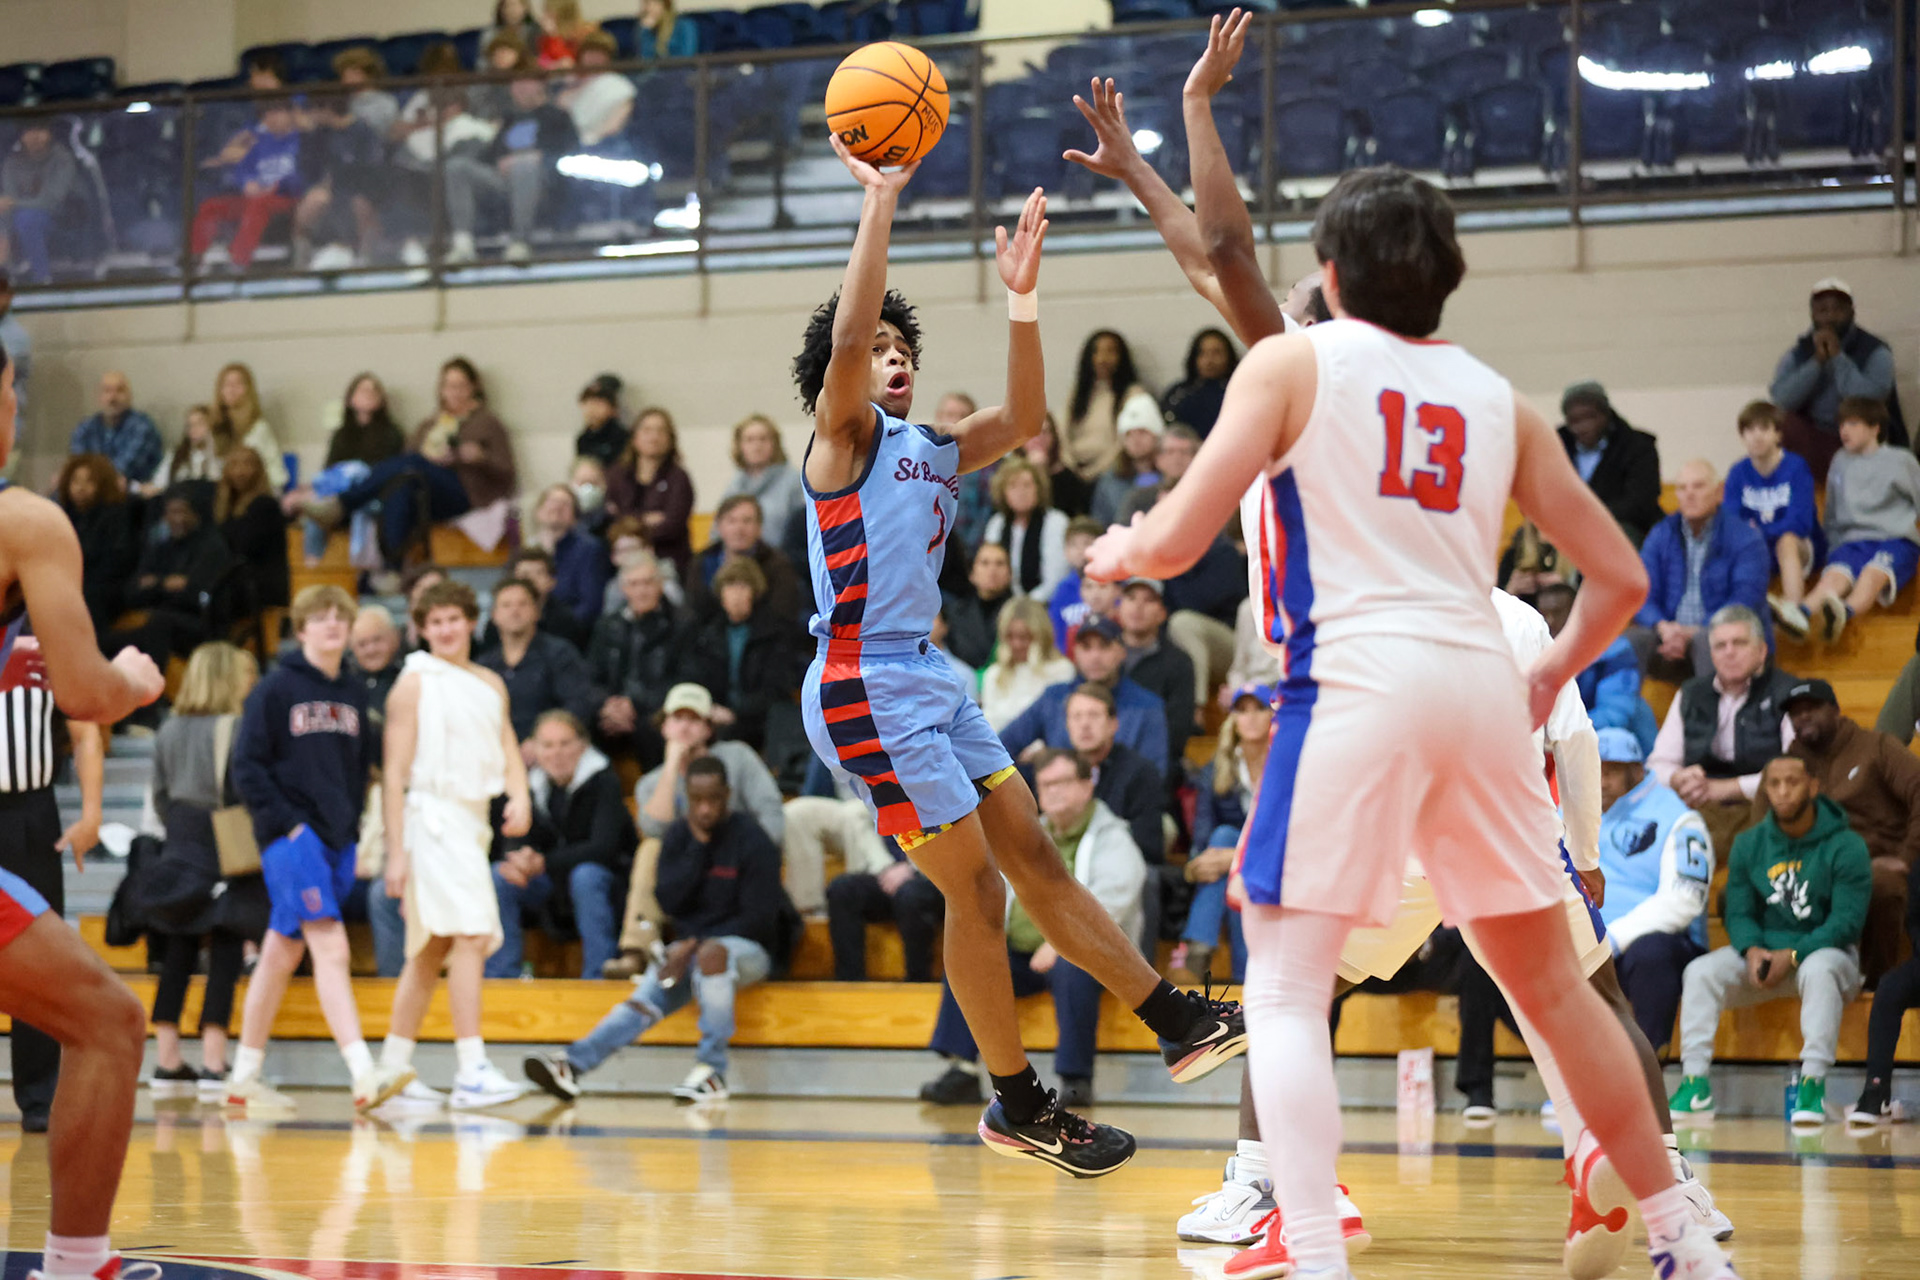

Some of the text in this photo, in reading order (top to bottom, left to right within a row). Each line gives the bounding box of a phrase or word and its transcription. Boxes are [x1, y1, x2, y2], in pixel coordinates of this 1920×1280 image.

[921, 106, 939, 134] MUS
[1377, 388, 1466, 513] 13
[894, 457, 920, 481] St
